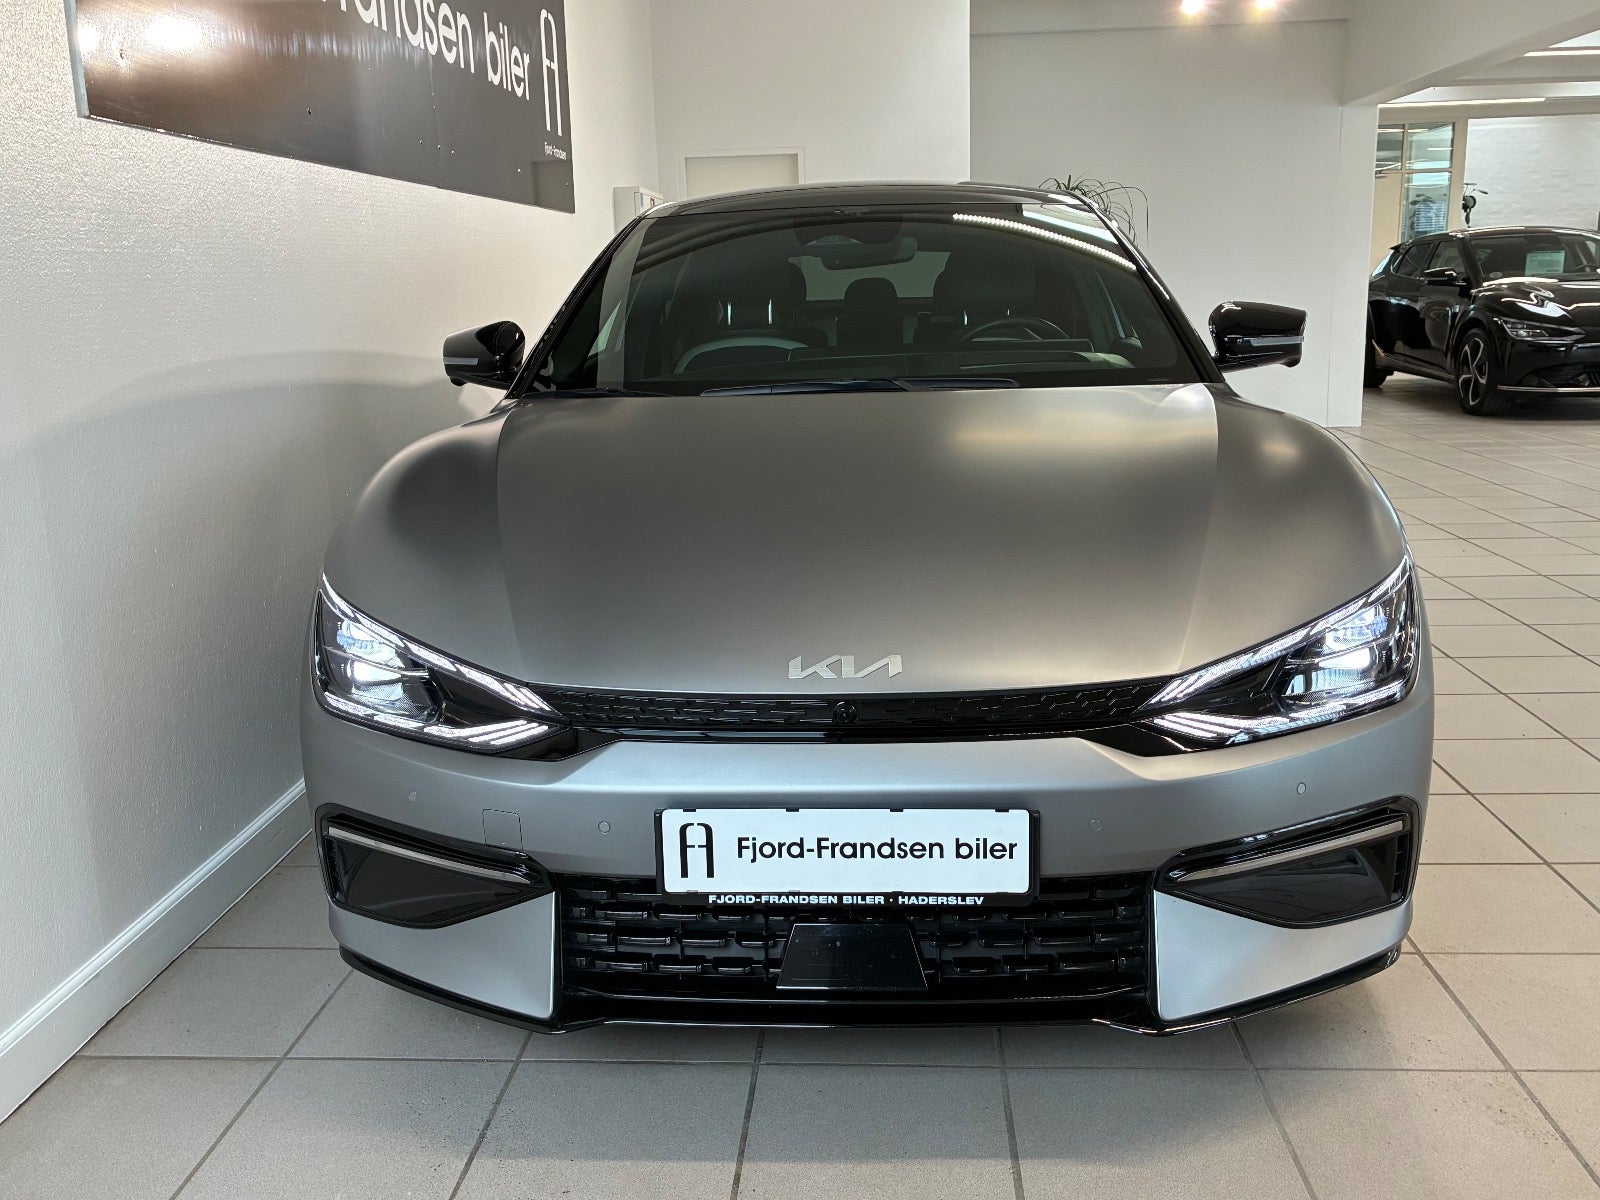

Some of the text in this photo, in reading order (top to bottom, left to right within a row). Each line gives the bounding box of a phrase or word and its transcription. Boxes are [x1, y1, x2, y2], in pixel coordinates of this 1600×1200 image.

[321, 0, 530, 100] dsen biler
[737, 837, 1018, 863] Fjord-Frandsen biler
[708, 895, 984, 905] FJORD-FRANDSEN BILER HADERSLEV
